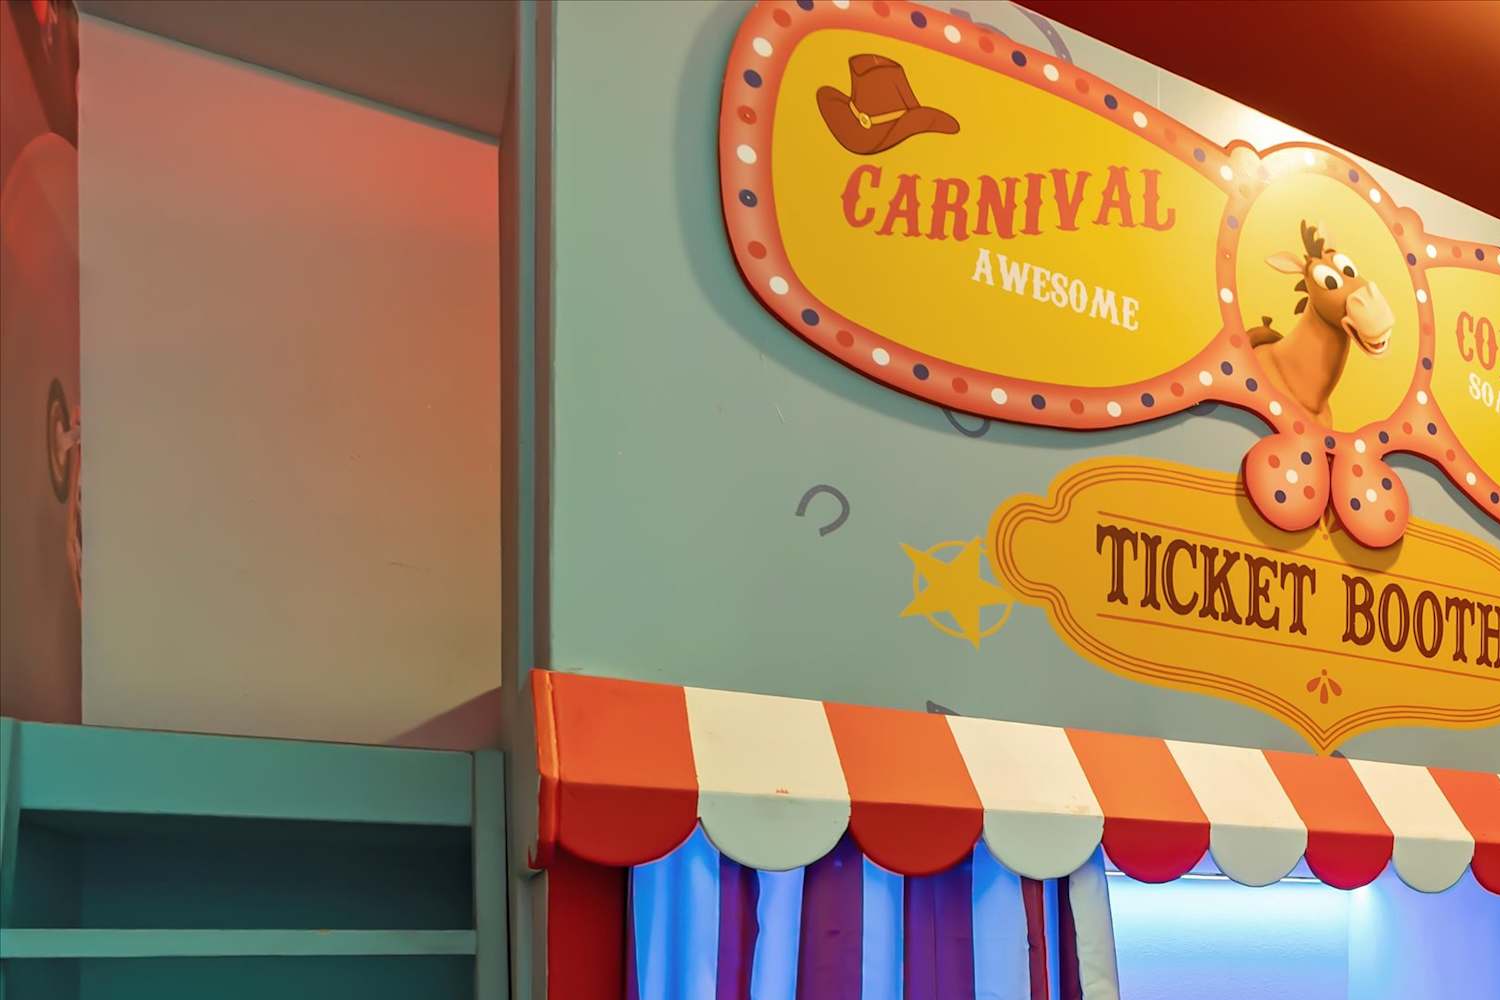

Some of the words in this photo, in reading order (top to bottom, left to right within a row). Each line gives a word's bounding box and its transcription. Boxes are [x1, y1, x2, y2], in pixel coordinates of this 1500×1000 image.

[840, 163, 1177, 242] CARNIVAL
[971, 247, 1141, 332] AWESOME
[1096, 523, 1317, 636] TICKET
